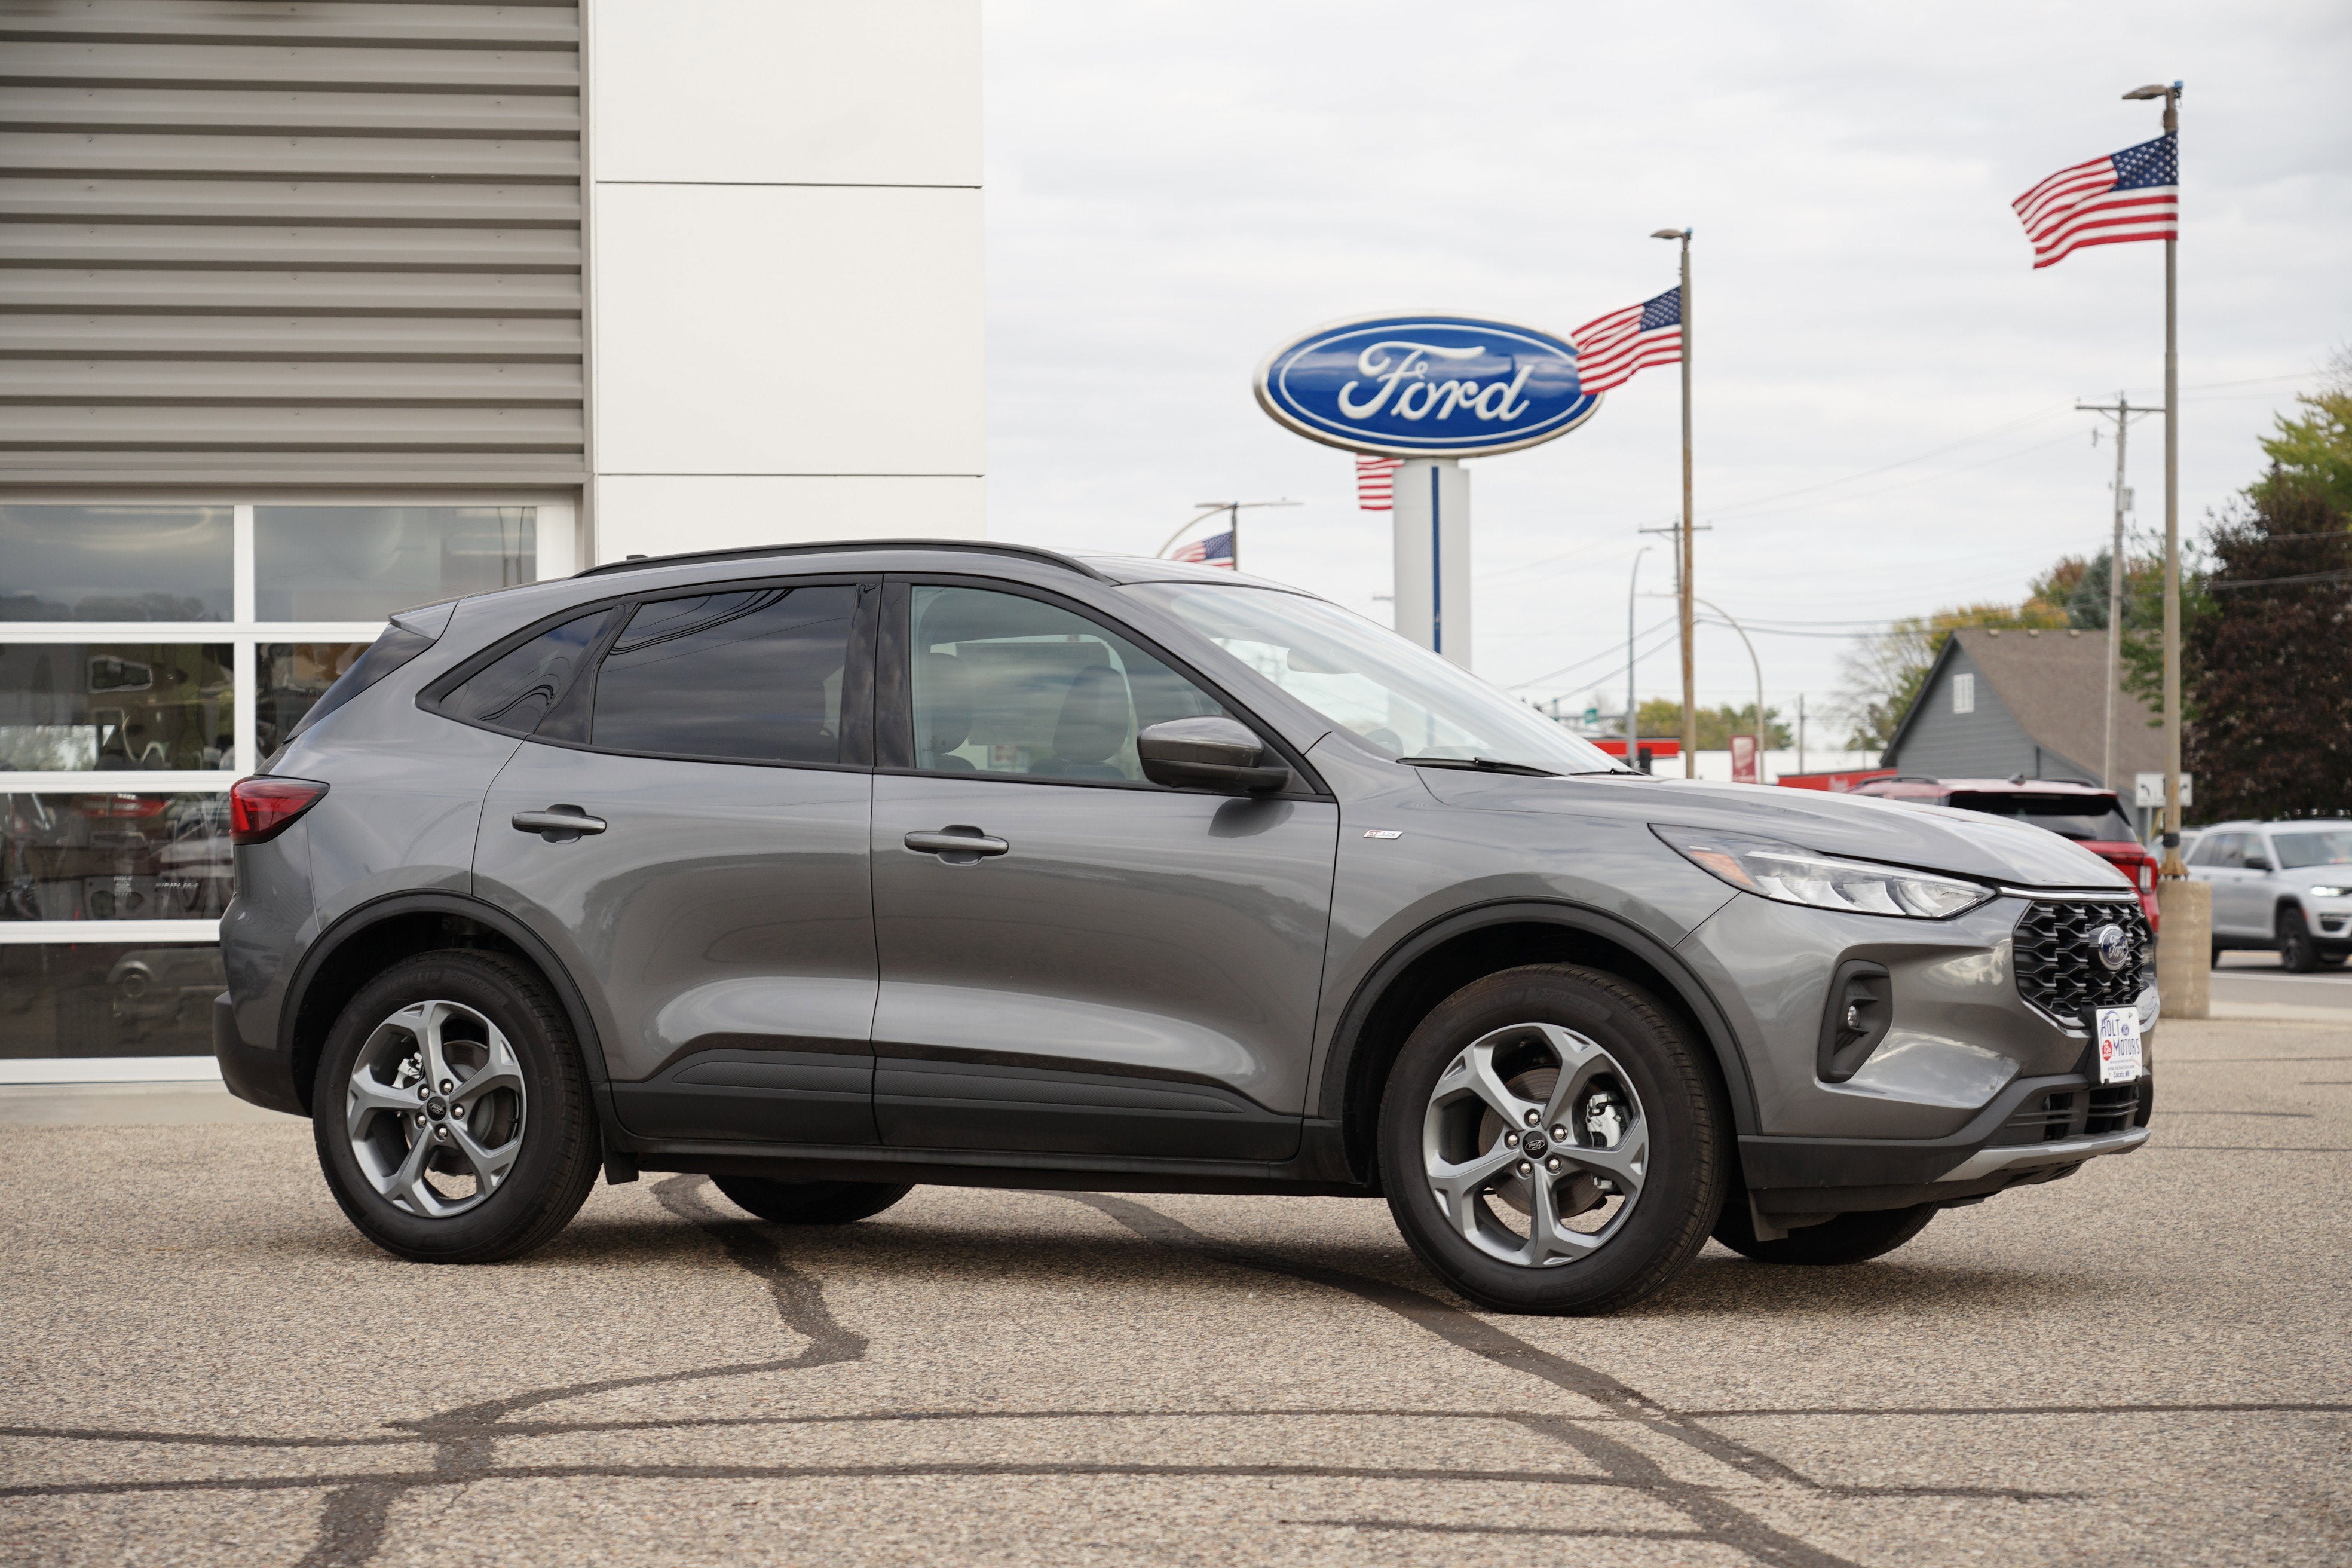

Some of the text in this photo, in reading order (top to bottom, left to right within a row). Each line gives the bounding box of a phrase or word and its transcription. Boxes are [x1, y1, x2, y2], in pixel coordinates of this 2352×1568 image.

[1337, 341, 1535, 421] Ford
[2109, 935, 2127, 958] Ford
[2100, 1018, 2120, 1037] HOLT
[2113, 1038, 2140, 1057] MOTORS
